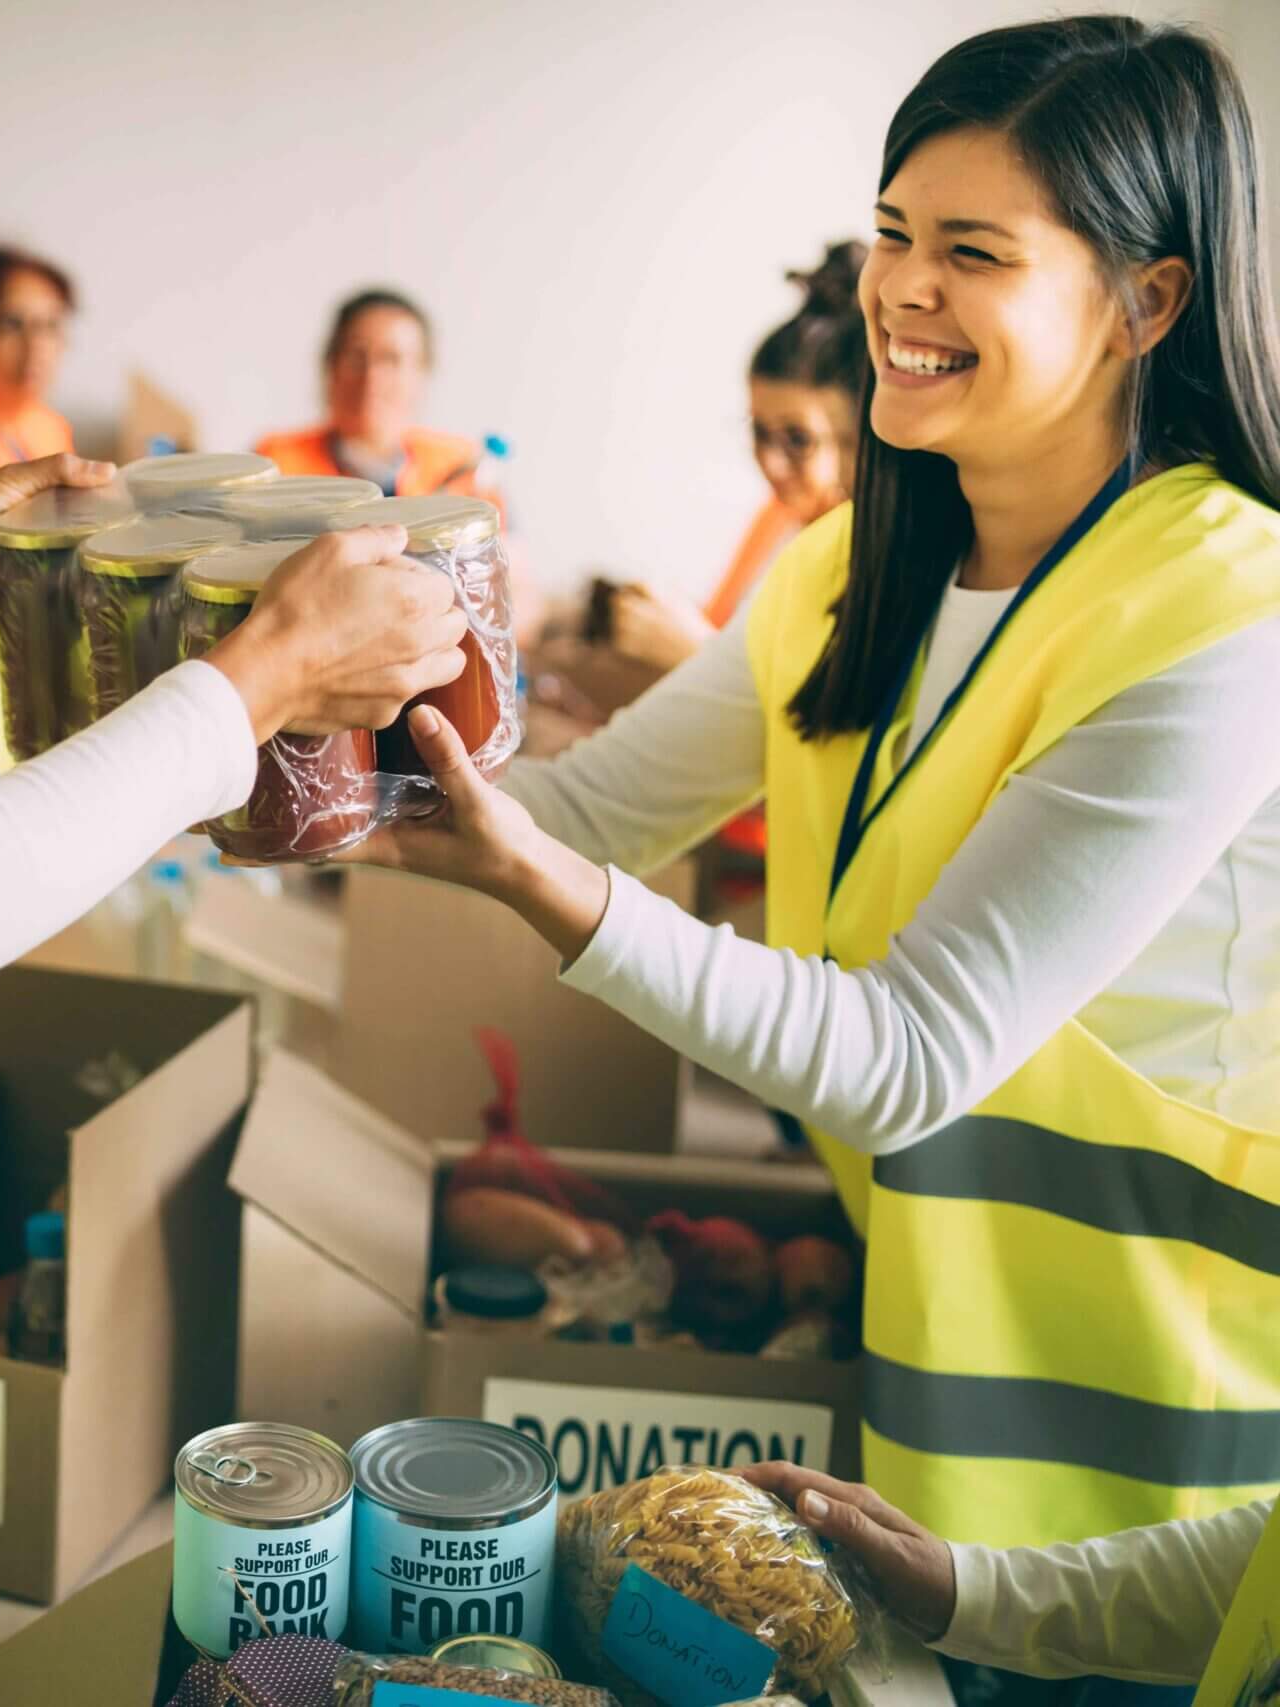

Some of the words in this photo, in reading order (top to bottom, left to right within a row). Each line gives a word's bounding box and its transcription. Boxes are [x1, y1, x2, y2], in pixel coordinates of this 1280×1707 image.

[234, 1557, 301, 1574] SUPPORT
[305, 1549, 329, 1569] OUR
[257, 1538, 312, 1557] PLEASE
[420, 1537, 499, 1561] PLEASE
[390, 1555, 484, 1587] SUPPORT
[489, 1556, 526, 1583] OUR
[233, 1572, 328, 1617] FOOD
[390, 1587, 524, 1645] FOOD
